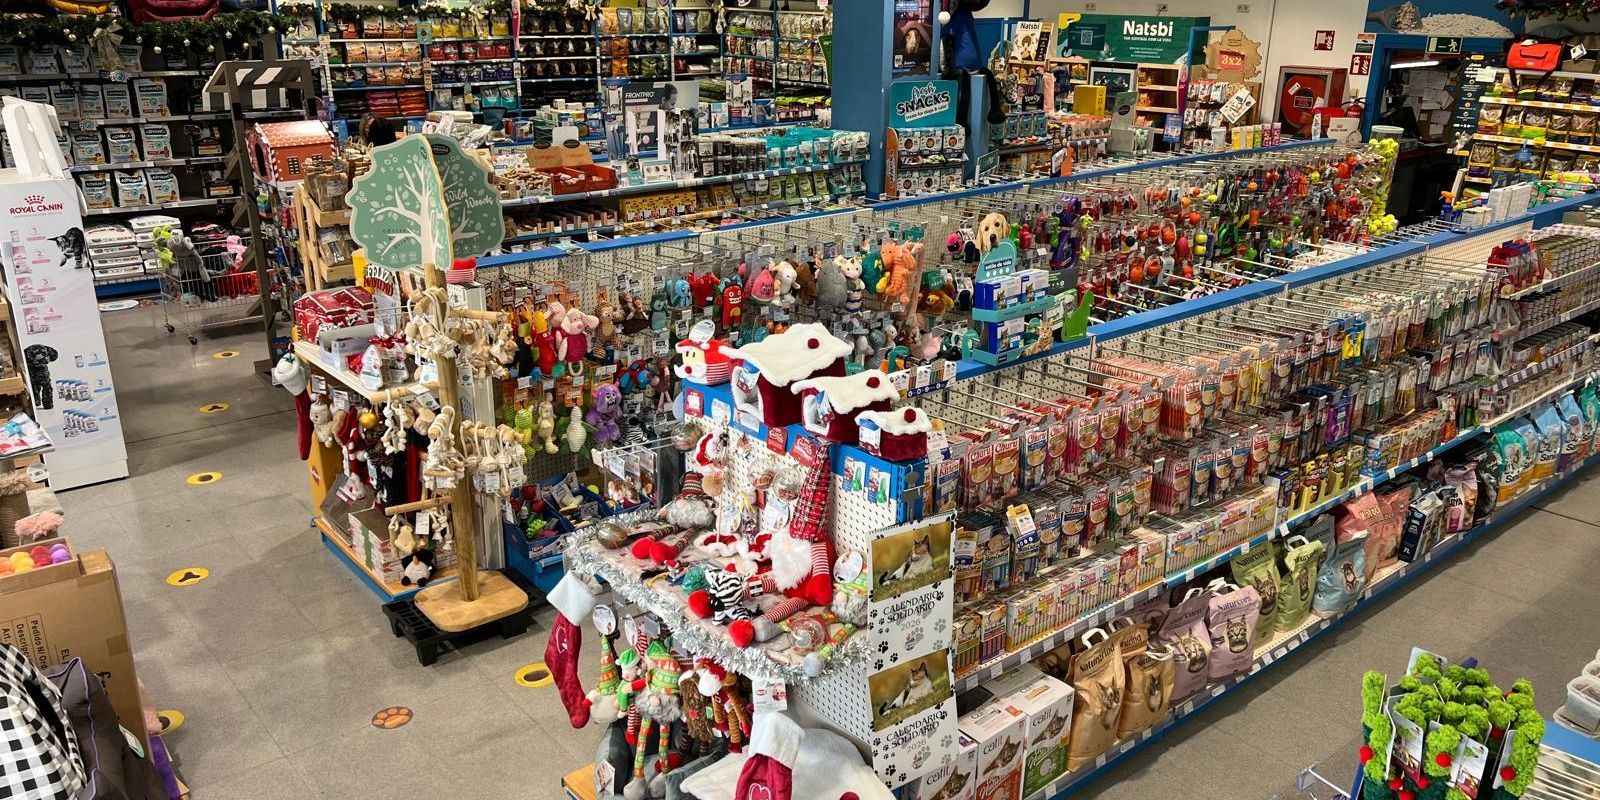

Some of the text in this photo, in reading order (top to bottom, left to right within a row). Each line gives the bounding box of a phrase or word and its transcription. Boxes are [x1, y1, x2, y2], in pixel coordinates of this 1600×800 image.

[1020, 22, 1040, 30] Natsbi
[1123, 20, 1174, 37] Natsbi
[1221, 55, 1242, 66] 3x2
[624, 91, 655, 99] FRONTPRO
[897, 91, 950, 115] SNACKS
[445, 188, 468, 202] Wild
[465, 195, 493, 209] Woods
[9, 203, 64, 215] ROYAL CANIN
[1028, 431, 1047, 444] Churu
[995, 440, 1018, 453] Churu
[970, 447, 992, 461] Churu
[883, 590, 939, 616] CALENDARIO
[887, 601, 935, 623] SOLIDARIO
[901, 618, 921, 631] 2026
[31, 620, 41, 646] Pedido
[886, 710, 943, 742] CALENDARIO
[892, 721, 940, 749] SOLIDARIO
[926, 765, 950, 785] catit
